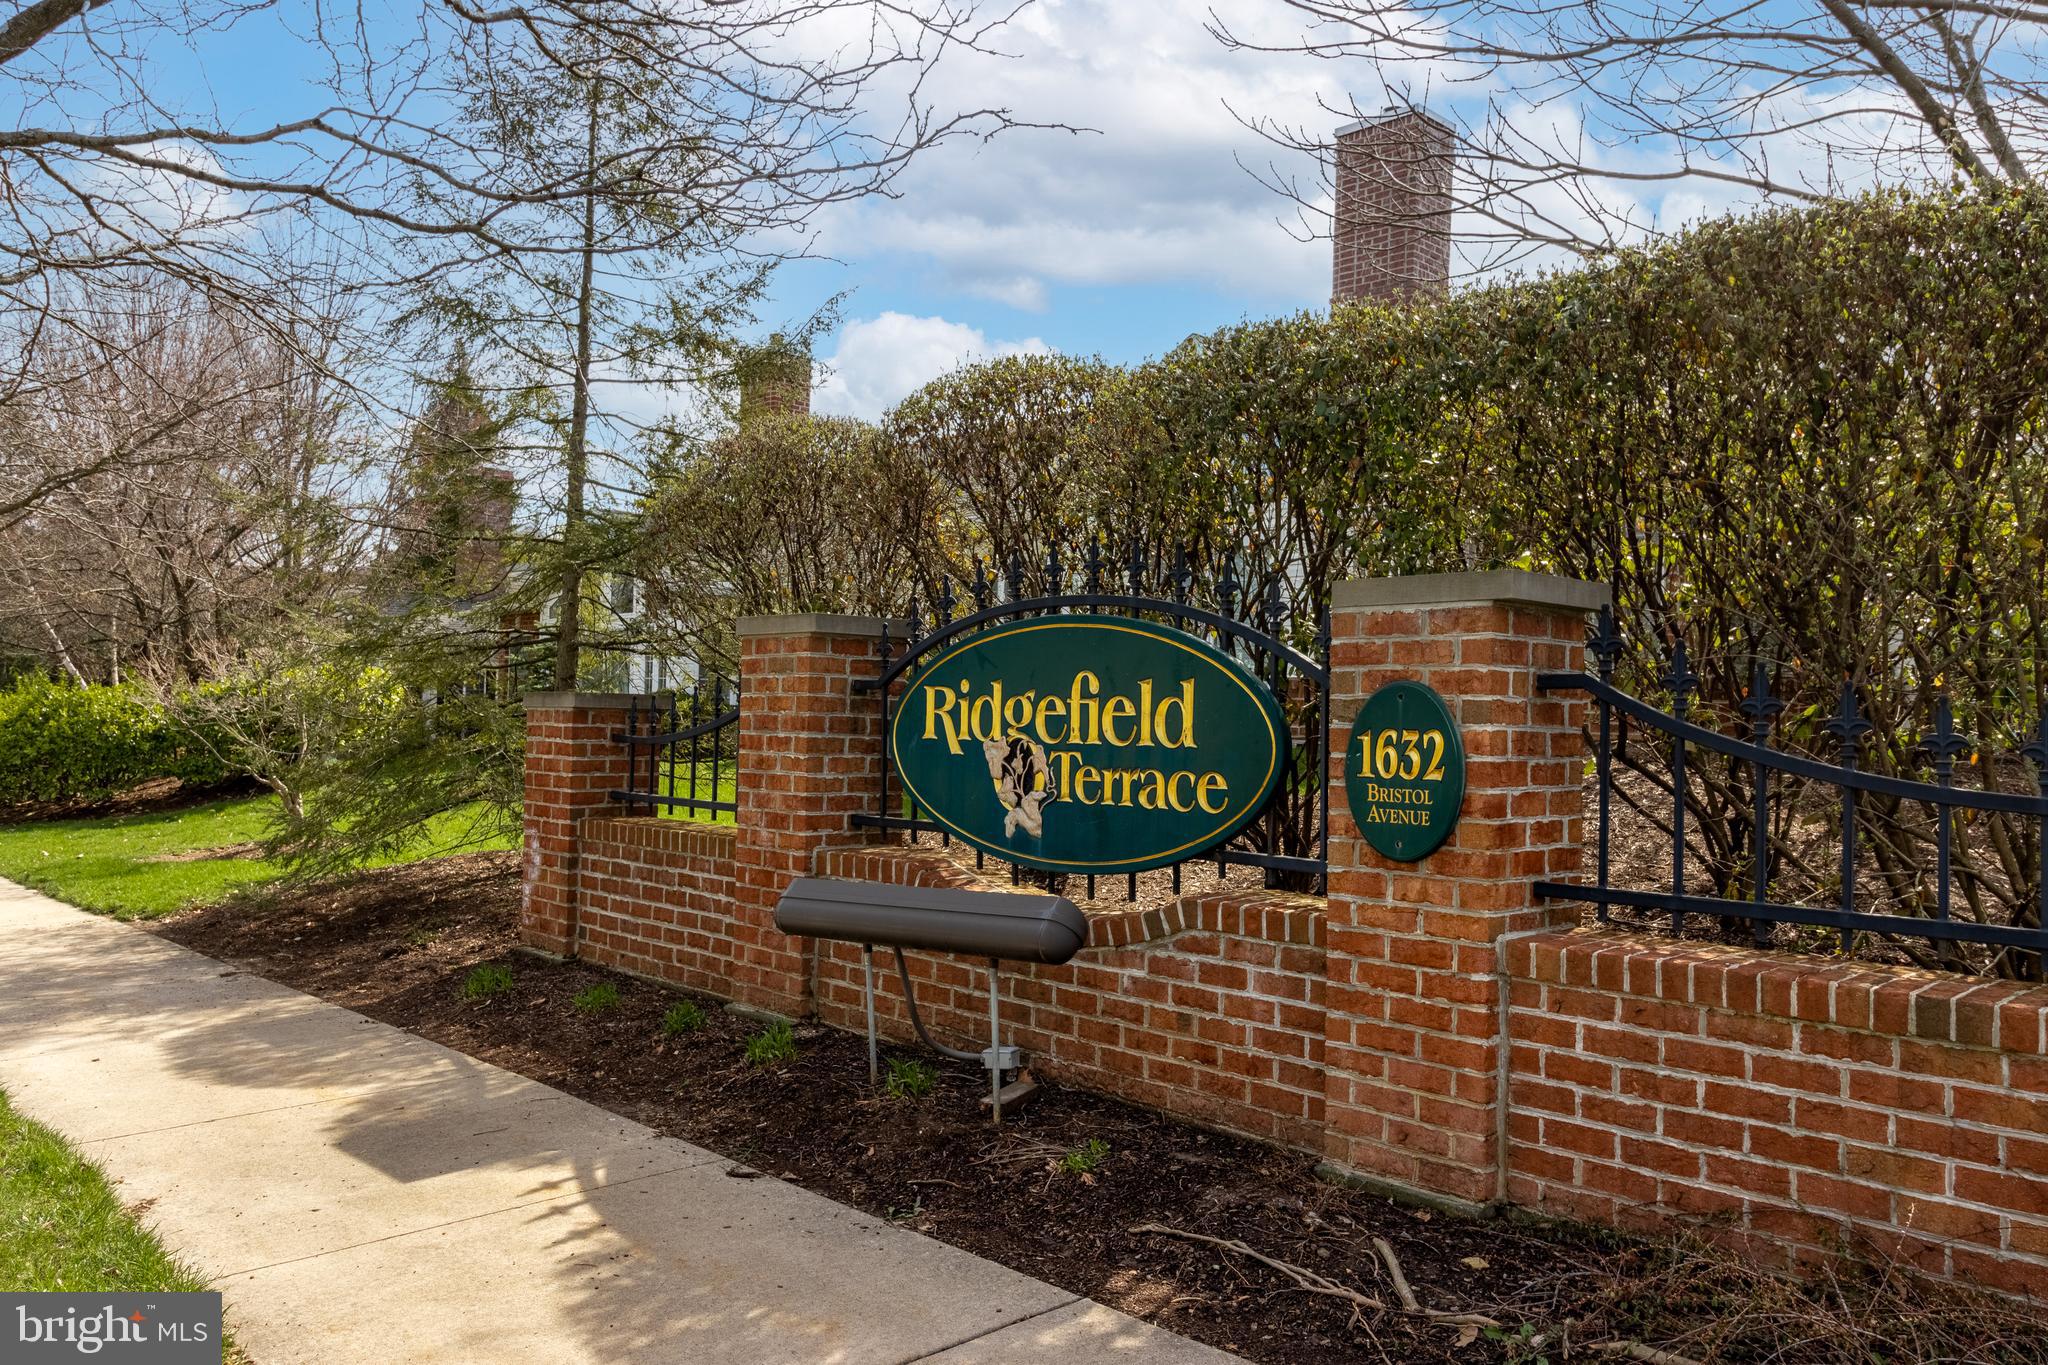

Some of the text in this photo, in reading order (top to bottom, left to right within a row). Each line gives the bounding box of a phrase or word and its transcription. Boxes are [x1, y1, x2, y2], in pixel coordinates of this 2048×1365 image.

[922, 669, 1198, 756] Ridgefield
[1356, 728, 1445, 781] 1632
[1048, 750, 1229, 814] Terrace
[1367, 783, 1433, 805] BRISTOL
[1366, 804, 1431, 826] AVENUE
